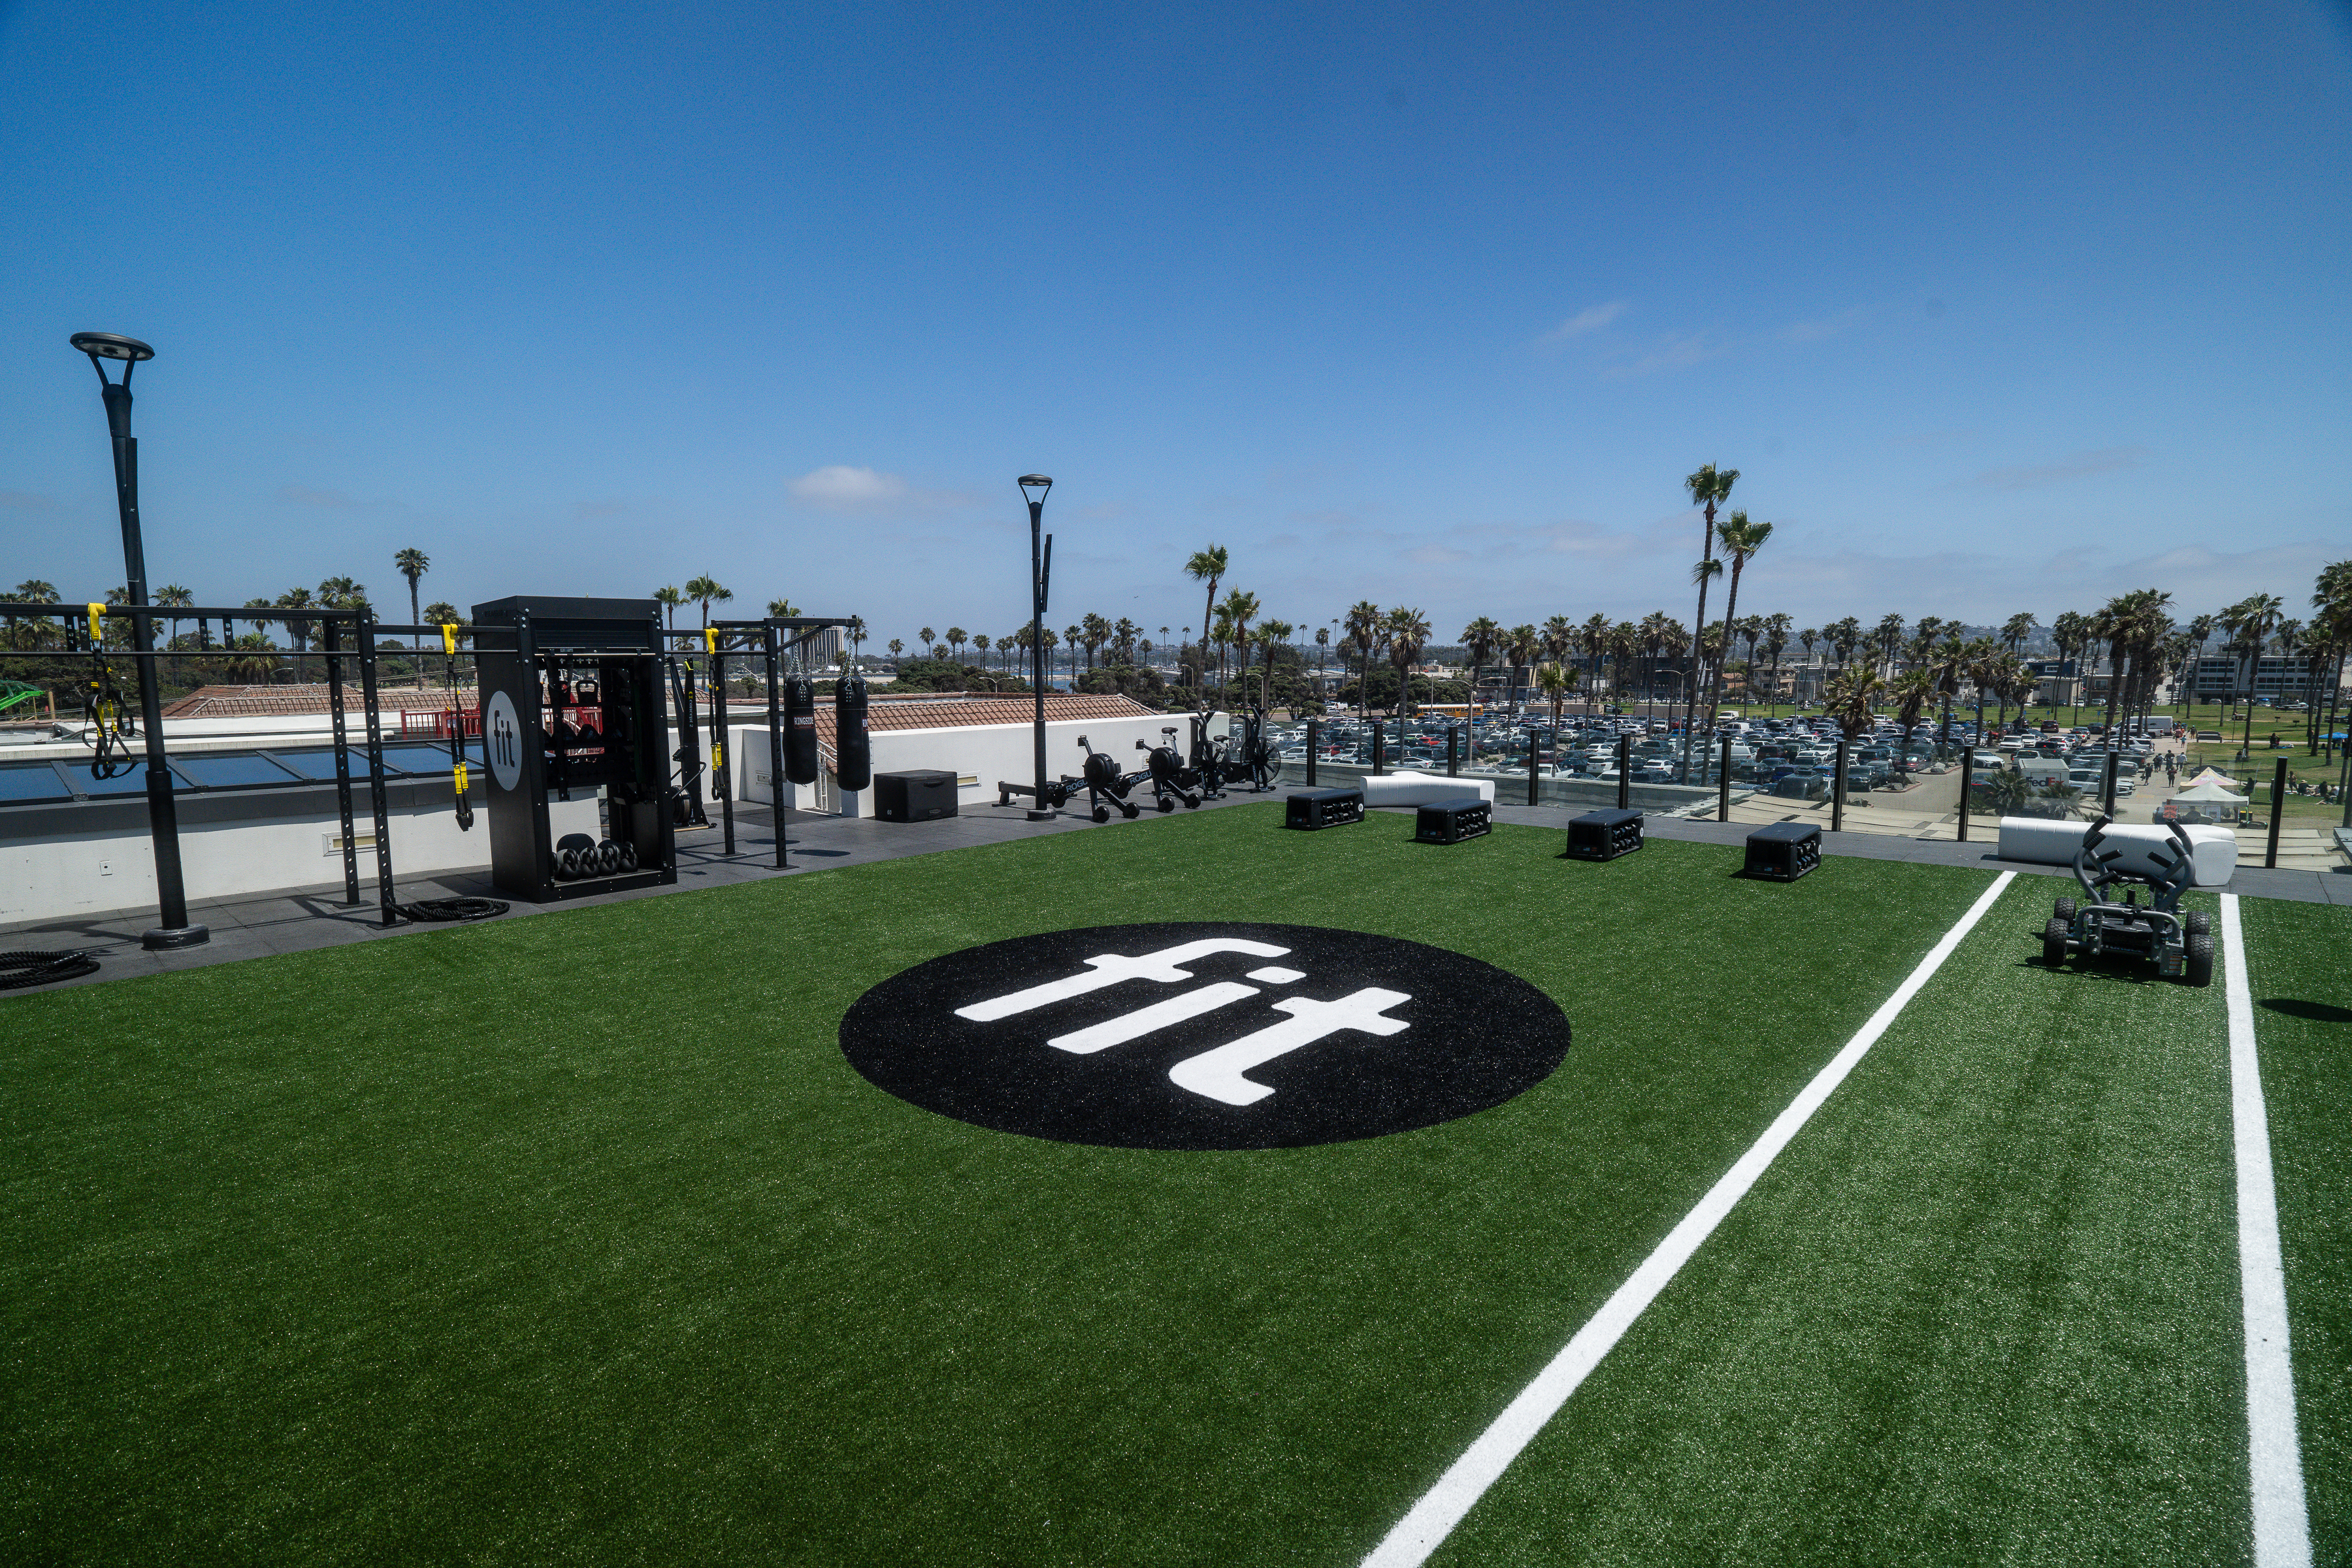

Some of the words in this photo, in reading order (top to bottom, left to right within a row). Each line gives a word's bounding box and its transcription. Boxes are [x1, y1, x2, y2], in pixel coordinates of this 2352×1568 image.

[794, 717, 814, 725] RINGSIDE
[494, 710, 515, 768] fit
[1130, 770, 1152, 784] ROGU
[1066, 779, 1088, 792] ROGU
[955, 938, 1412, 1105] fit
